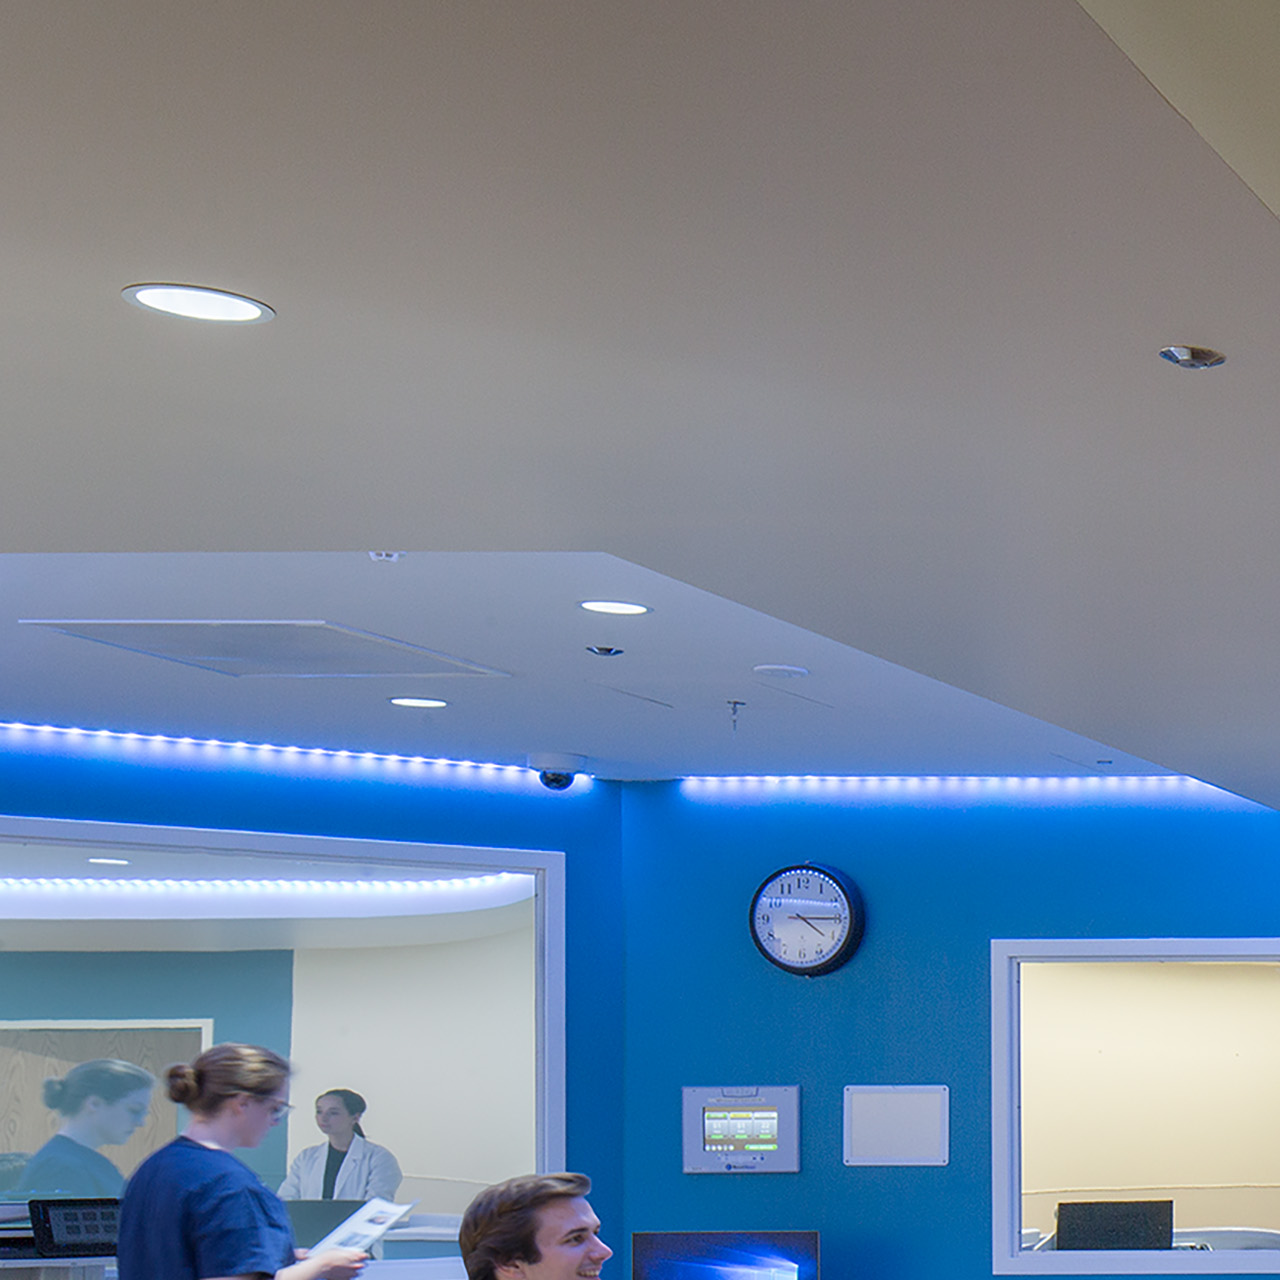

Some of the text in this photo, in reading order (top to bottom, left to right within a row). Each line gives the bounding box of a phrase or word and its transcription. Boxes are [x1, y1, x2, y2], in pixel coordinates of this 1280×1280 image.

[780, 883, 792, 894] 11
[797, 878, 810, 889] 12
[768, 897, 782, 908] 10
[761, 914, 770, 925] 9
[798, 948, 807, 959] 6
